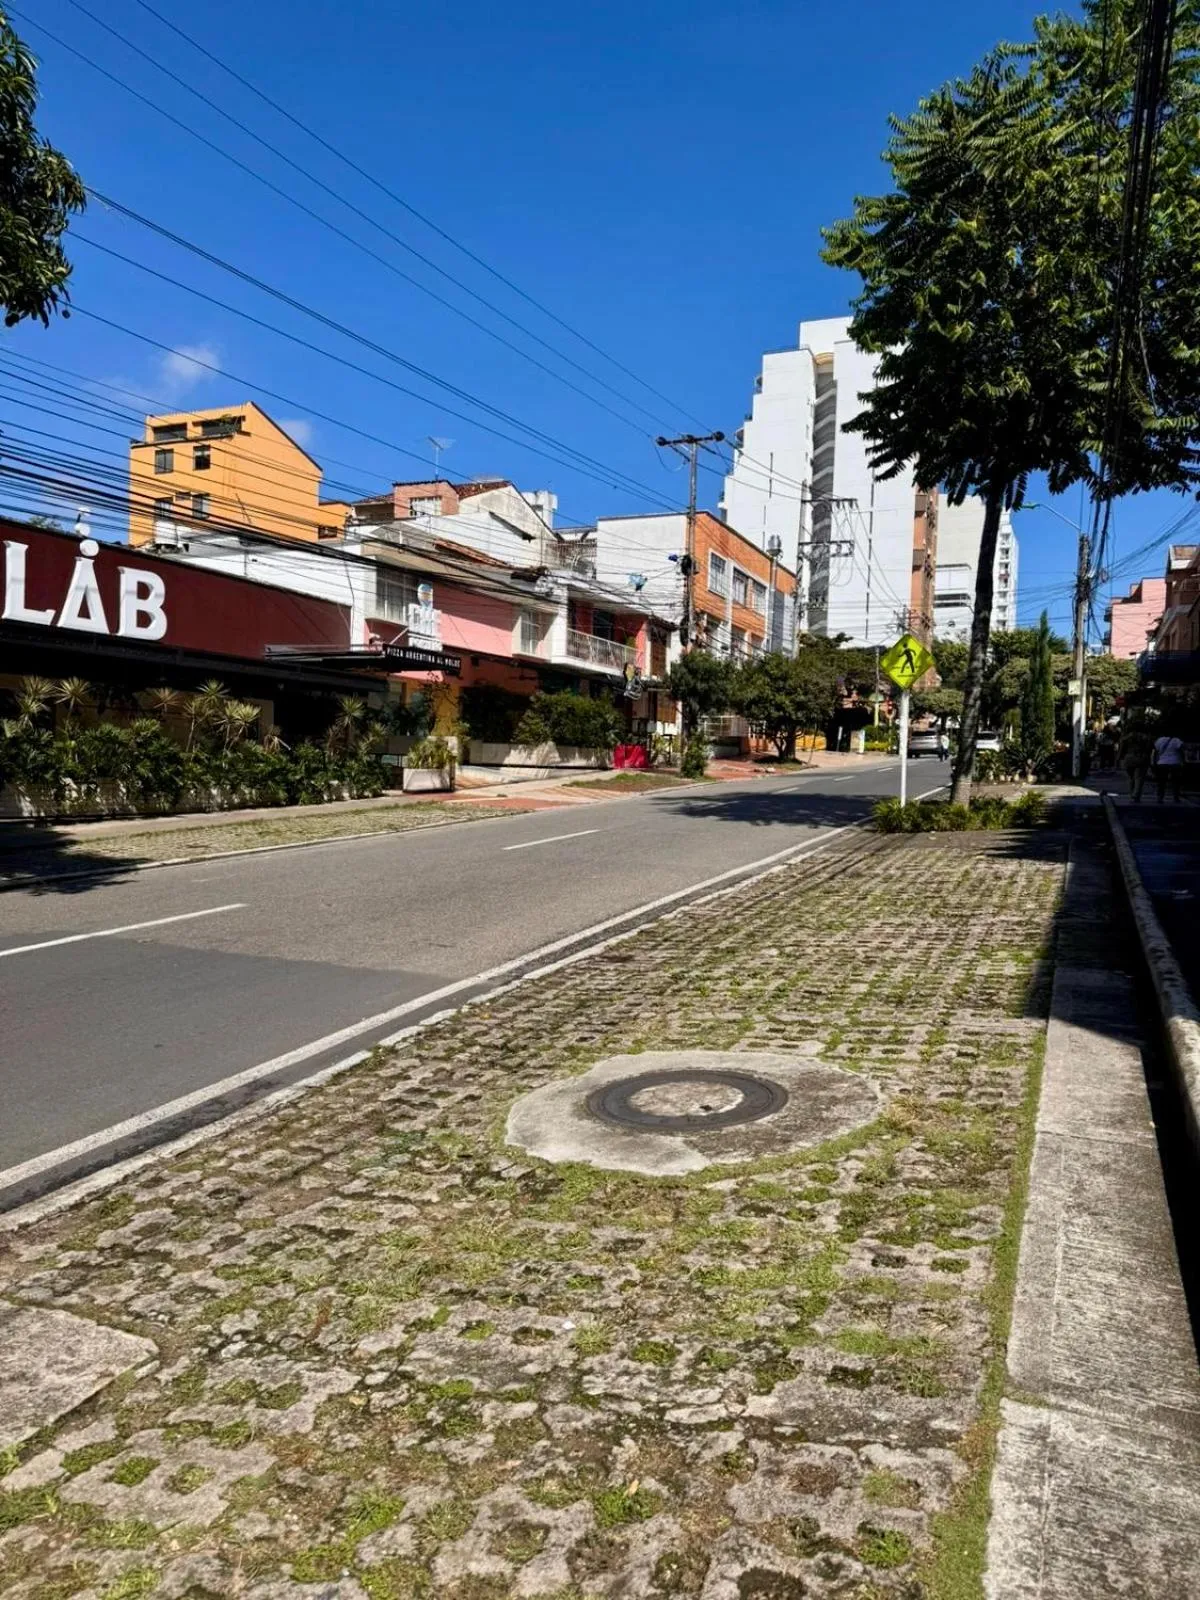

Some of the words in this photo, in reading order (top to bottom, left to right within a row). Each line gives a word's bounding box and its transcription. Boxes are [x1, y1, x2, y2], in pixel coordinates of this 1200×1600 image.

[1, 539, 168, 641] LAB
[386, 647, 404, 657] PIZZA
[405, 650, 435, 663] ARGENTINA
